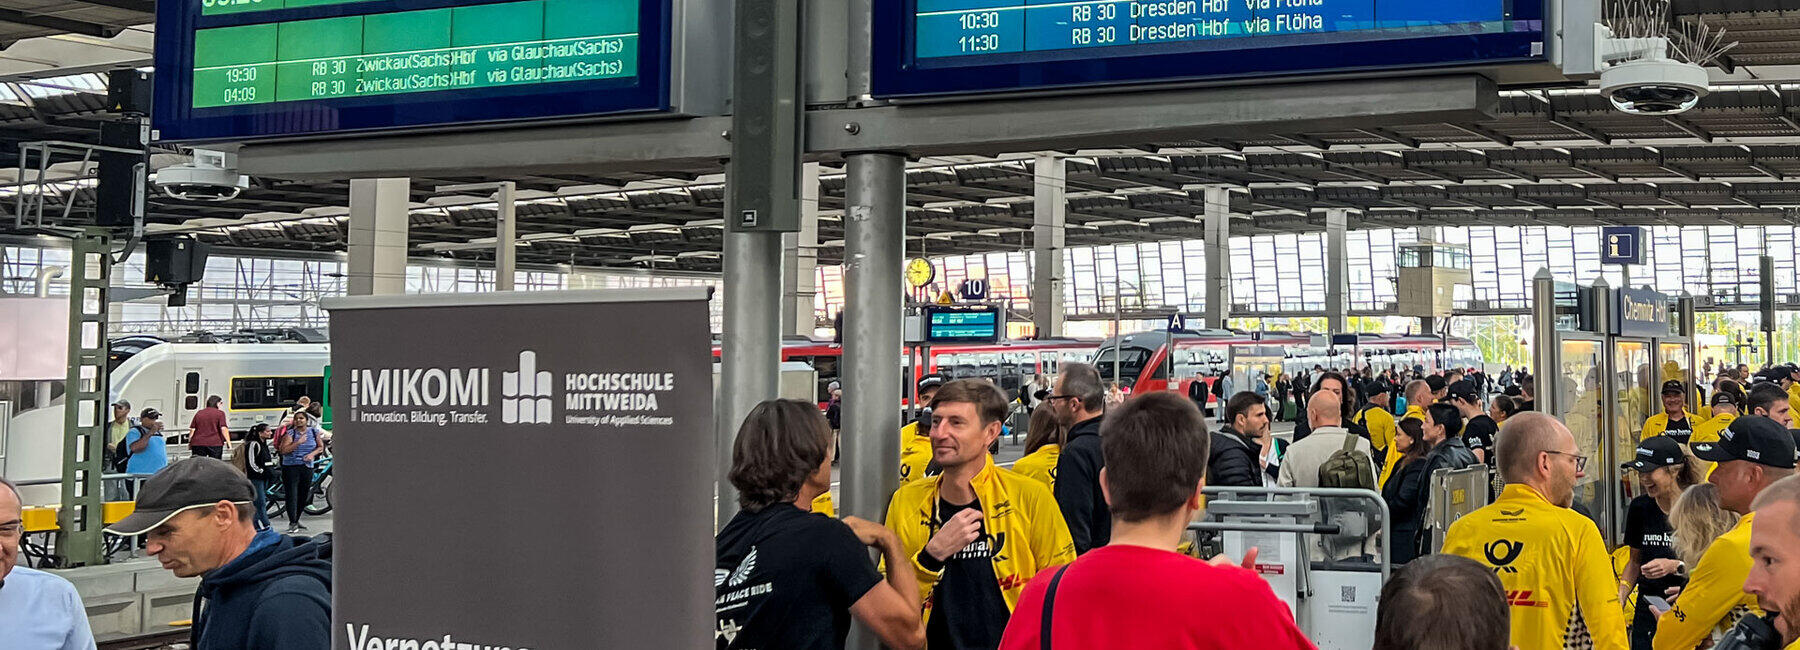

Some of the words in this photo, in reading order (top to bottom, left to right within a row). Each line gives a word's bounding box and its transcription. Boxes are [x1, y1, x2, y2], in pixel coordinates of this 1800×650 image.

[959, 12, 999, 30] 10:30
[1072, 5, 1091, 22] RB
[1097, 3, 1116, 20] 30
[1129, 0, 1196, 18] Dresden
[1202, 0, 1229, 13] Hbf
[959, 34, 999, 52] 11:30
[1072, 28, 1091, 45] RB
[1097, 26, 1116, 43] 30
[1129, 22, 1196, 41] Dresden
[1202, 18, 1230, 36] Hbf
[1245, 16, 1270, 33] via
[1276, 13, 1323, 31] Flöha
[225, 67, 257, 83] 19:30
[312, 61, 327, 76] RB
[331, 59, 346, 75] 30
[356, 50, 477, 73] Zwickau(Sachs)Hbf
[487, 48, 508, 63] via
[511, 38, 624, 61] Glauchau(Sachs)
[224, 87, 256, 103] 04:09
[311, 81, 326, 96] RB
[330, 80, 346, 95] 30
[355, 70, 477, 93] Zwickau(Sachs)Hbf
[487, 69, 507, 83] via
[511, 59, 623, 82] Glauchau(Sachs)
[965, 280, 982, 295] 10
[1624, 294, 1654, 322] Chemnitz
[1170, 313, 1182, 329] A
[361, 368, 490, 406] MIKOMI
[565, 372, 674, 391] HOCHSCHULE
[565, 393, 659, 411] MITTWEIDA
[361, 411, 409, 423] Innovation.
[410, 411, 448, 426] Bildung.
[449, 410, 489, 424] Transfer.
[565, 415, 600, 427] University
[600, 414, 610, 424] of
[610, 415, 640, 427] Applied
[751, 582, 773, 596] RIDE
